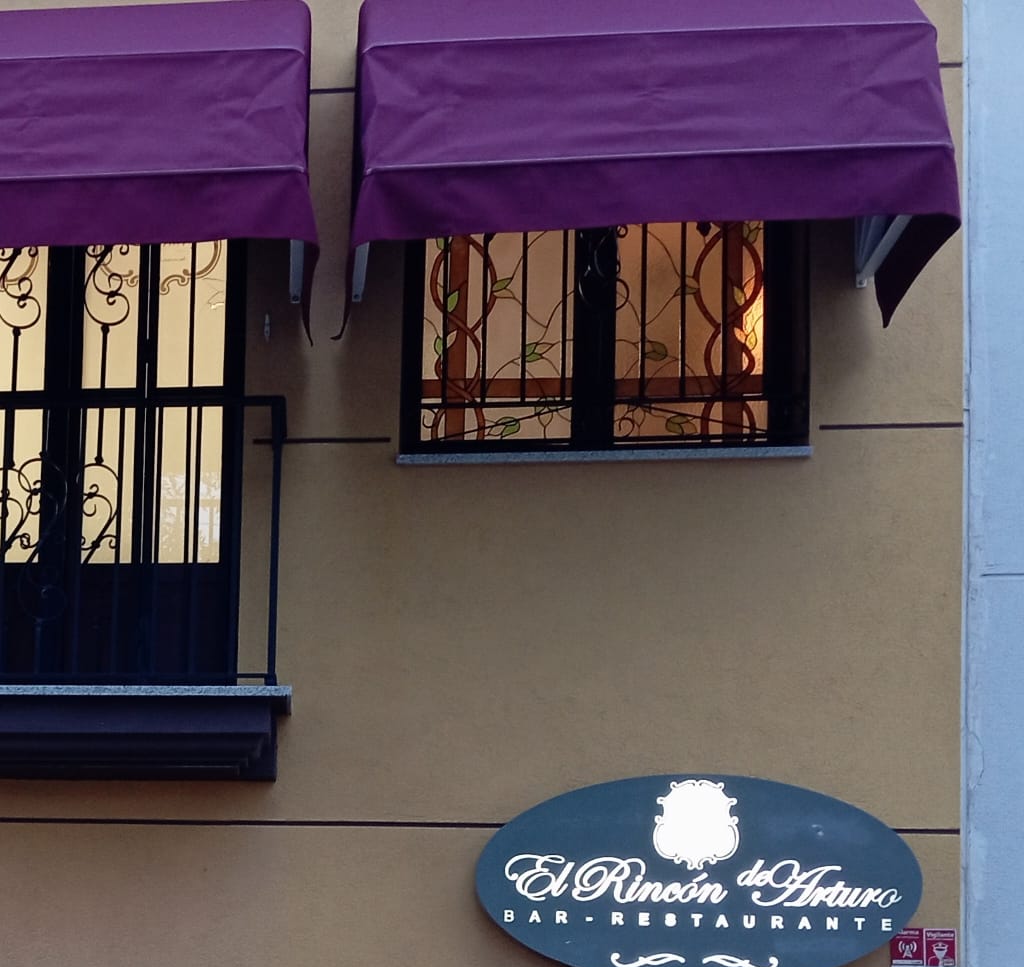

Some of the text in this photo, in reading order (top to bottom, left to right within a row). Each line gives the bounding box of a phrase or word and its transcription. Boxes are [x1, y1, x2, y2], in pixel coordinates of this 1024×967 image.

[504, 854, 903, 908] El Rincón de Arturo
[926, 931, 955, 939] Vigilante
